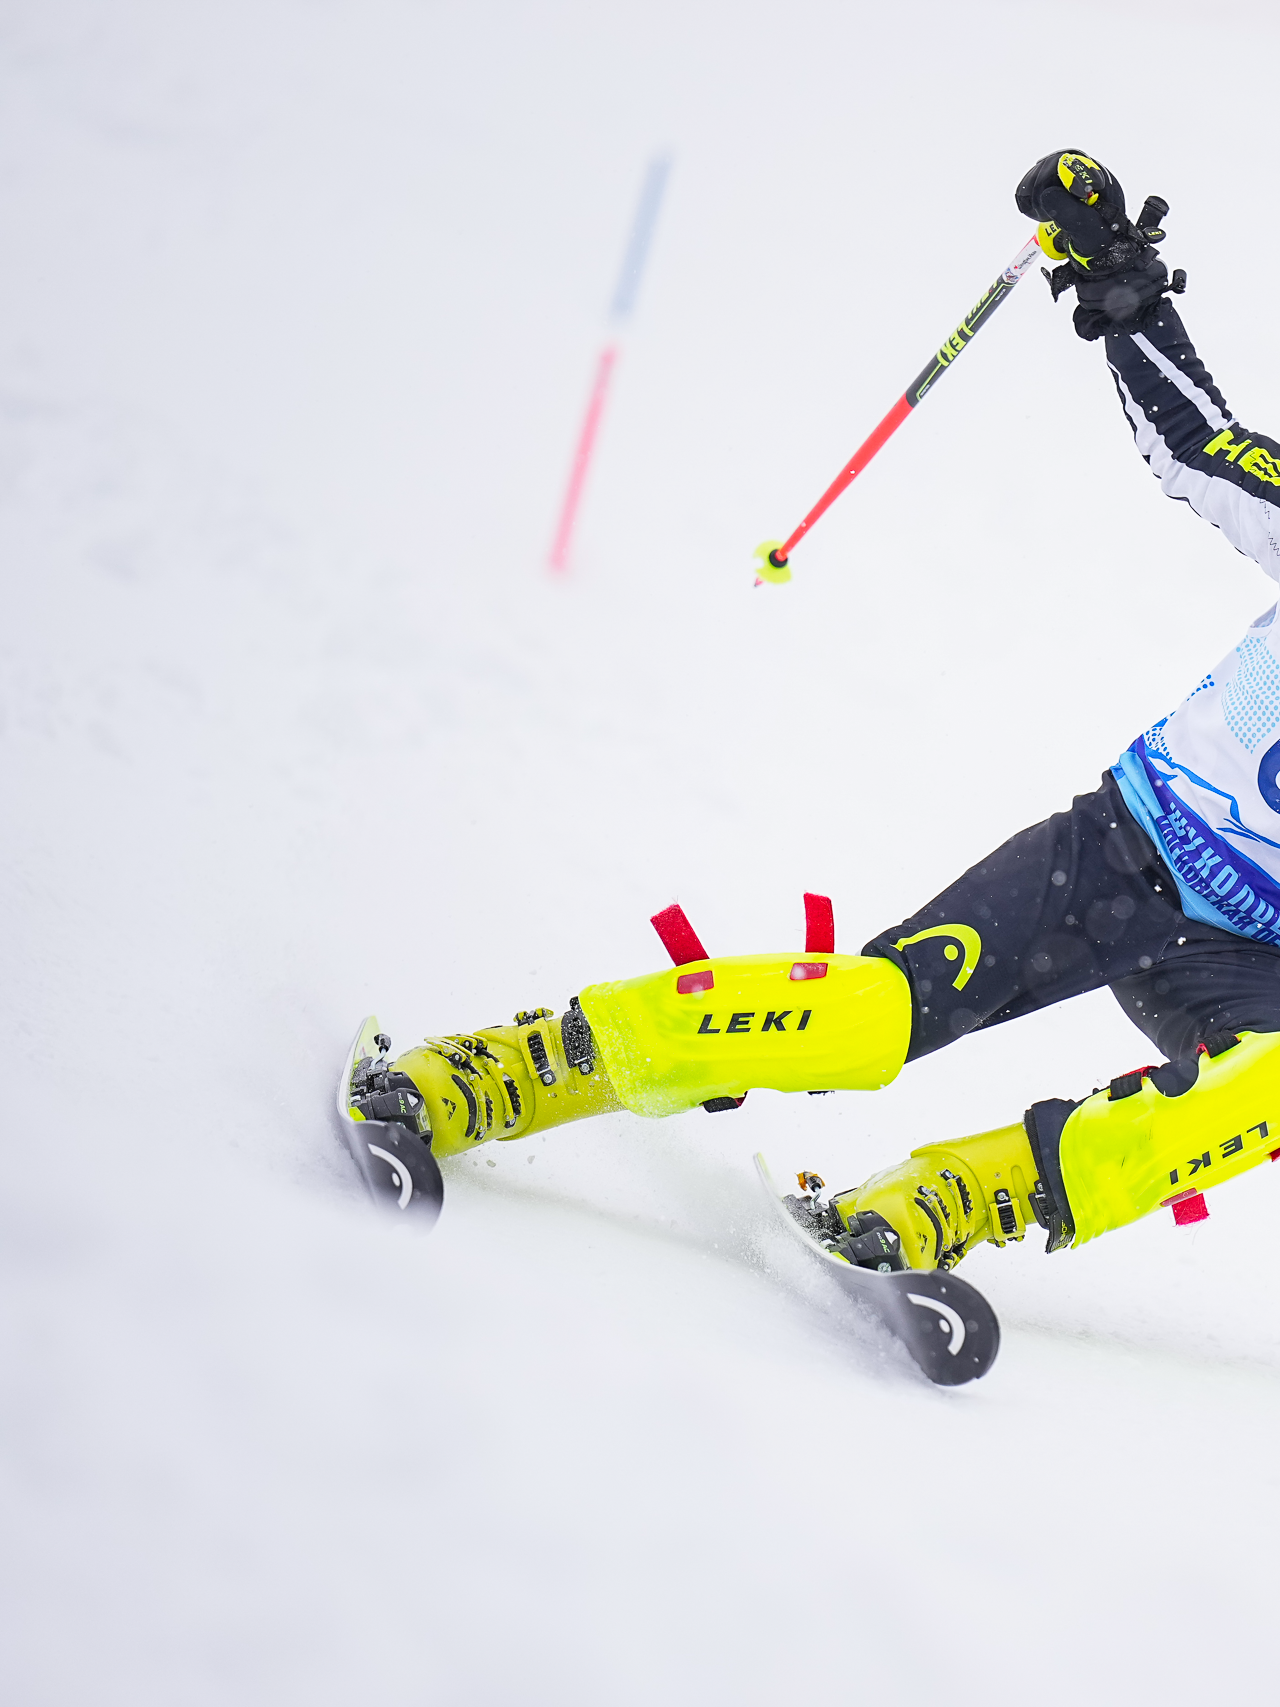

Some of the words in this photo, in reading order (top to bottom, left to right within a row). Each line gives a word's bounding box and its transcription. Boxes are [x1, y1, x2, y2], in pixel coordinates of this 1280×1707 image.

[936, 319, 975, 367] LEKI
[697, 1010, 813, 1035] LEKI
[1169, 1120, 1270, 1186] LEKI
